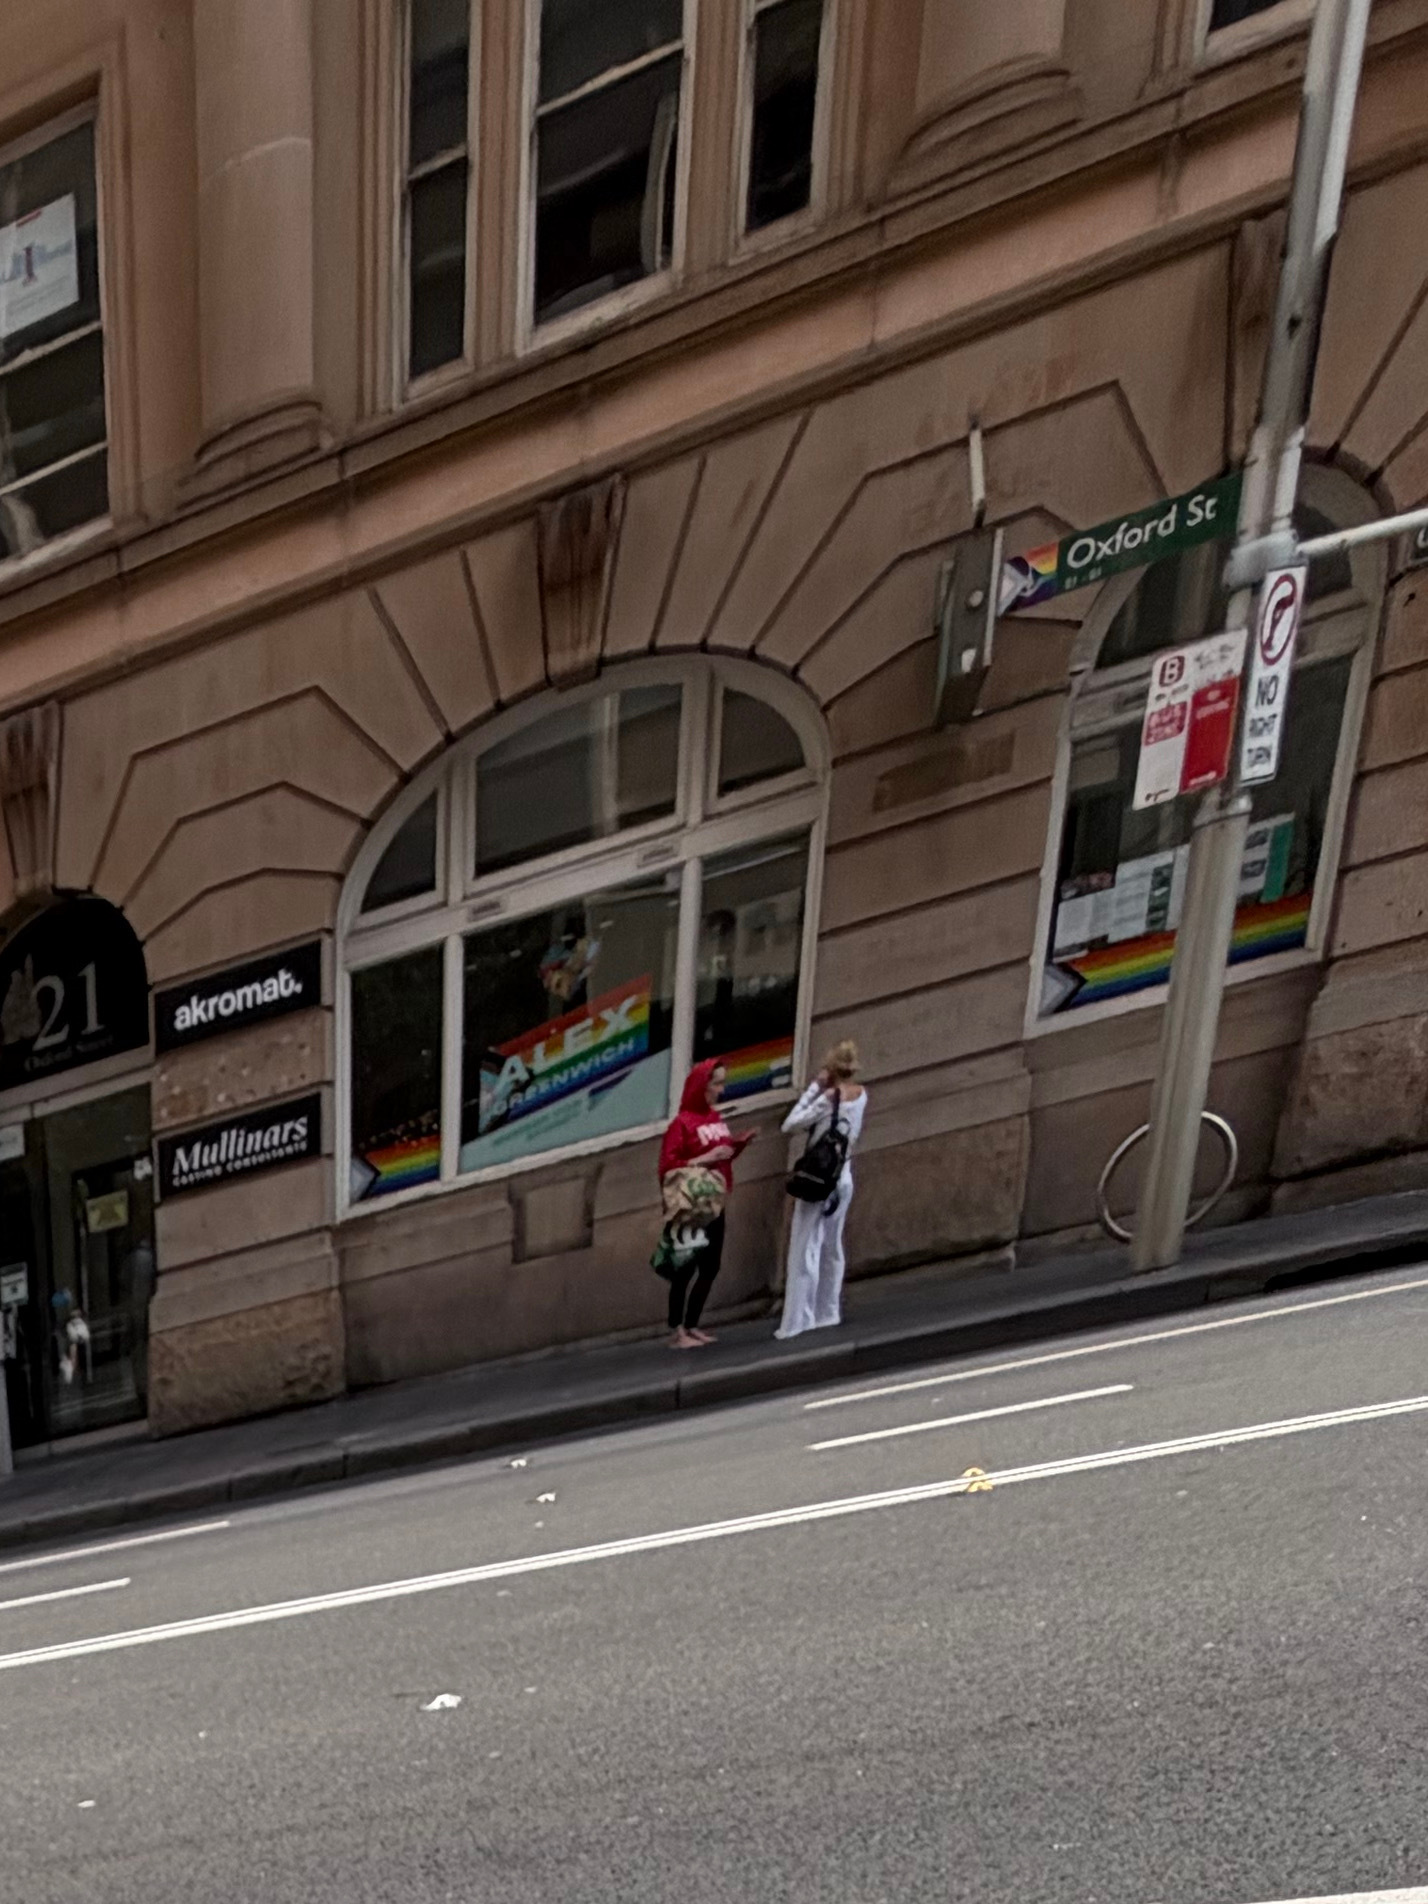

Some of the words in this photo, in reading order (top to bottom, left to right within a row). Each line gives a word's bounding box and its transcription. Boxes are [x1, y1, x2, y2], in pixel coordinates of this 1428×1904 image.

[1067, 504, 1177, 568] Oxford
[1186, 494, 1218, 527] St
[1255, 675, 1279, 706] NO
[31, 960, 107, 1051] 21
[172, 967, 304, 1032] akromat.
[492, 1037, 636, 1118] GREENWICH
[497, 994, 640, 1107] ALEX
[172, 1116, 308, 1176] Mullinars
